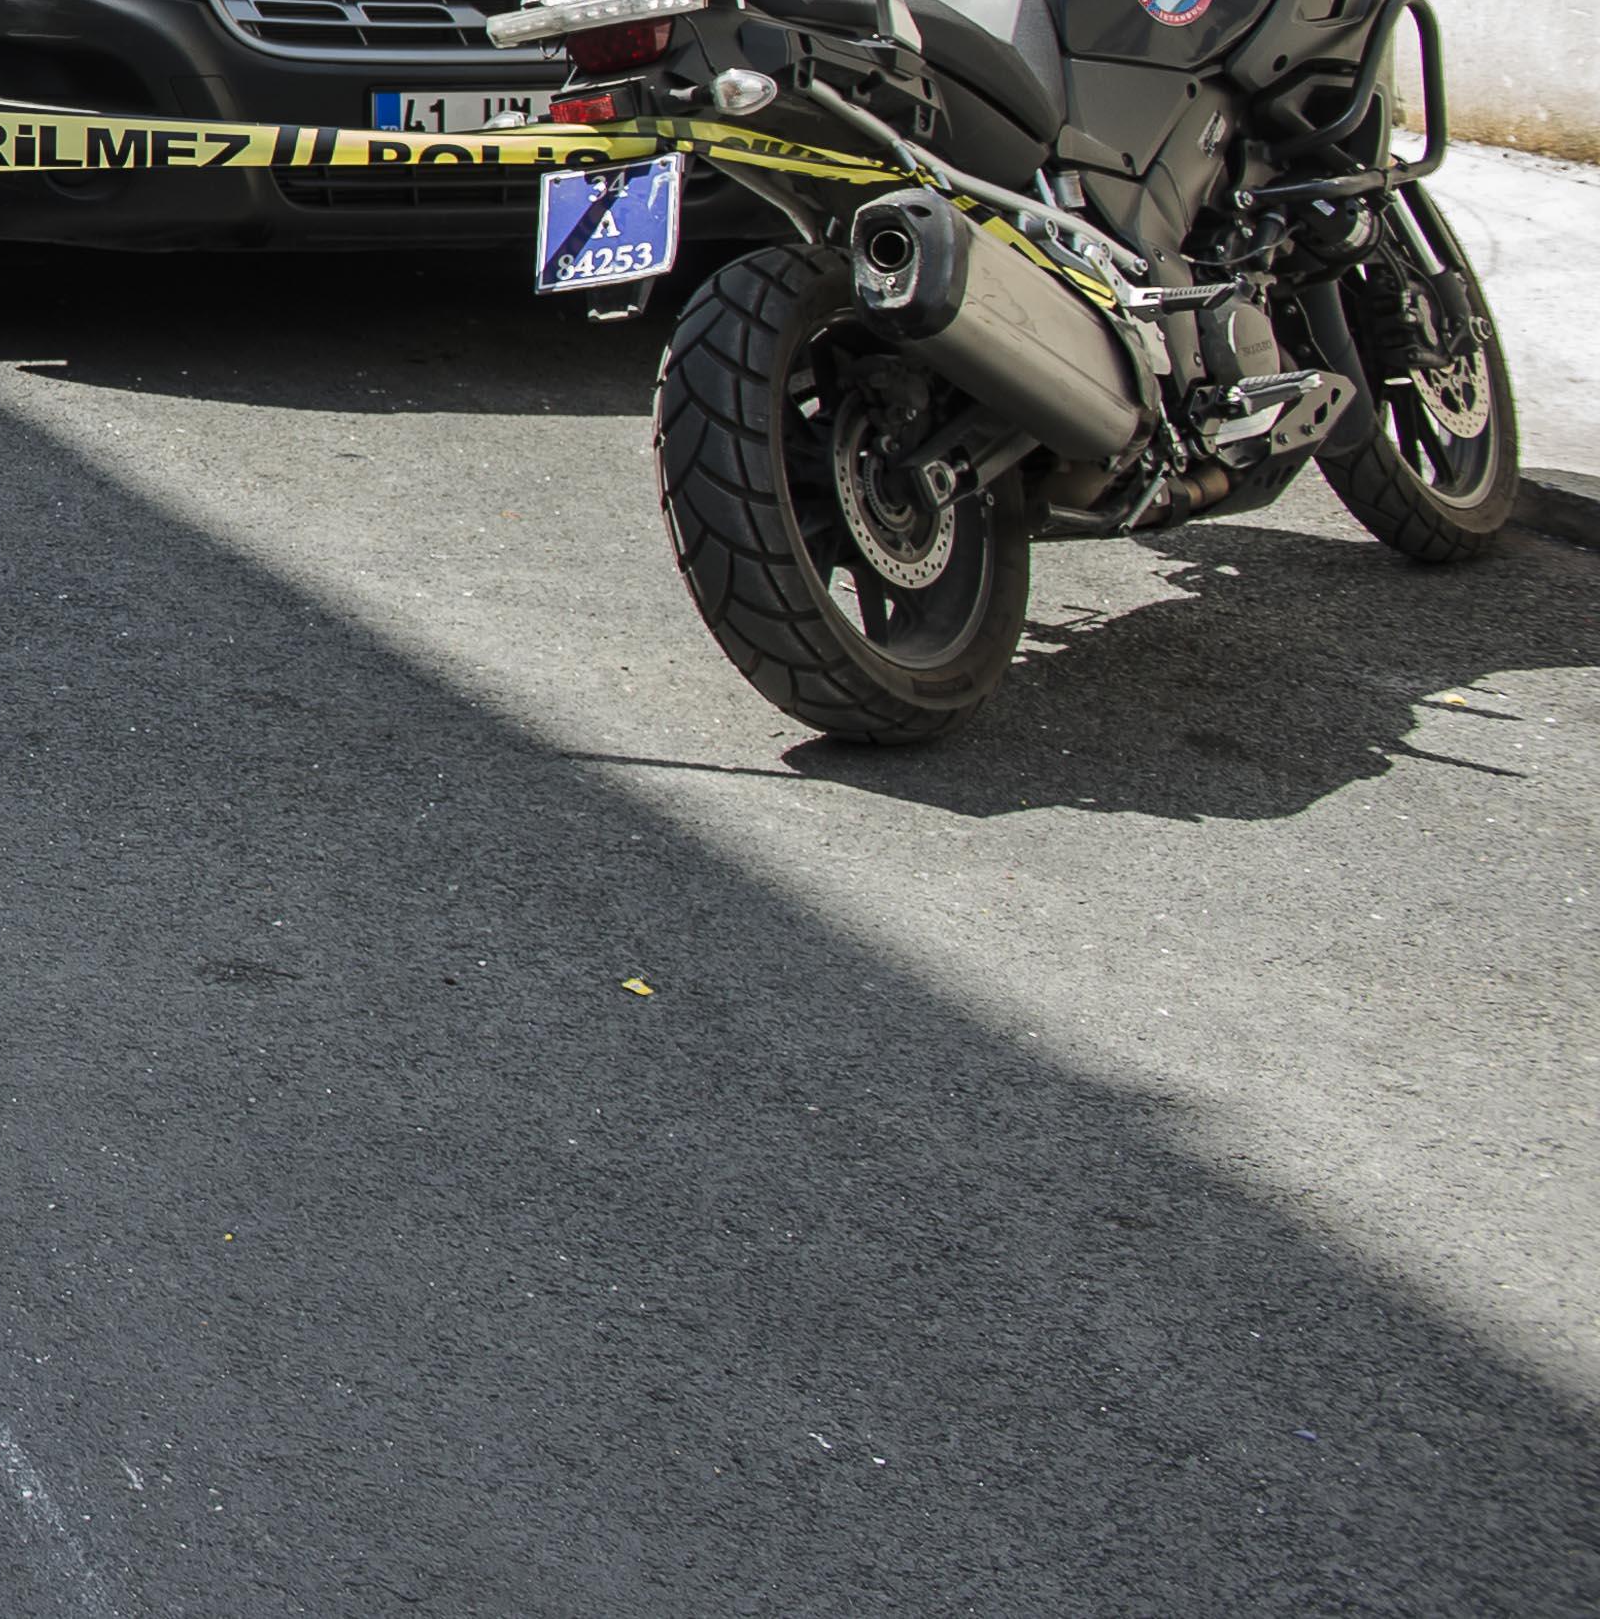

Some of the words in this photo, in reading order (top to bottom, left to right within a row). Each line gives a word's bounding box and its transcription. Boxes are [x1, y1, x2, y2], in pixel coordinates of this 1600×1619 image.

[588, 171, 629, 202] 34
[592, 209, 621, 239] A
[557, 242, 653, 281] 84253
